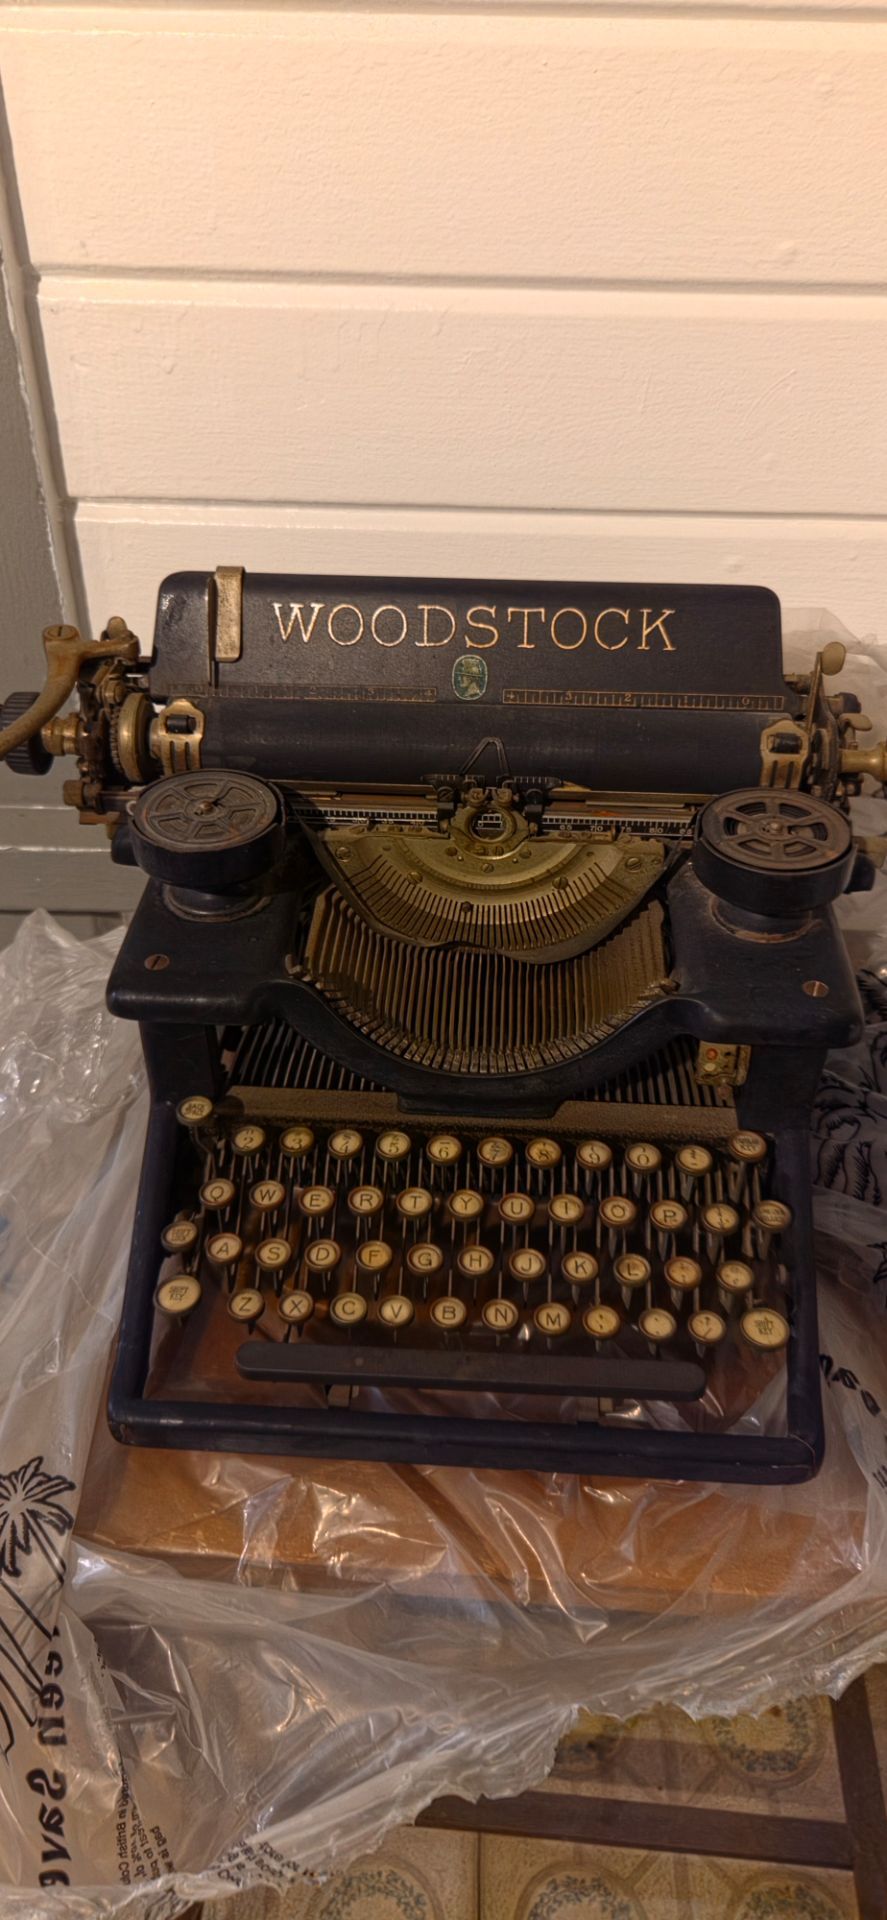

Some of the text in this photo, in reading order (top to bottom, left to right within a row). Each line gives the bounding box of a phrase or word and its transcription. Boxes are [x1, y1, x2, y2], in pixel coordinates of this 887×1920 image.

[272, 602, 677, 651] WOODSTOCK
[624, 692, 632, 702] 2
[243, 1136, 254, 1149] 2
[292, 1138, 303, 1149] 3
[340, 1140, 350, 1154] 4
[388, 1142, 399, 1153] 5
[438, 1146, 449, 1160] 6
[588, 1152, 601, 1164] 9
[636, 1153, 650, 1166] 0
[210, 1186, 225, 1202] Q
[259, 1188, 277, 1202] W
[310, 1193, 321, 1207] E
[359, 1193, 373, 1207] R
[410, 1195, 422, 1208] T
[460, 1197, 473, 1210] Y
[510, 1201, 522, 1215] U
[611, 1204, 626, 1219] O
[662, 1209, 676, 1223] P
[216, 1241, 639, 1277] A S D F G H J K L
[238, 1296, 561, 1328] Z X C V B N M
